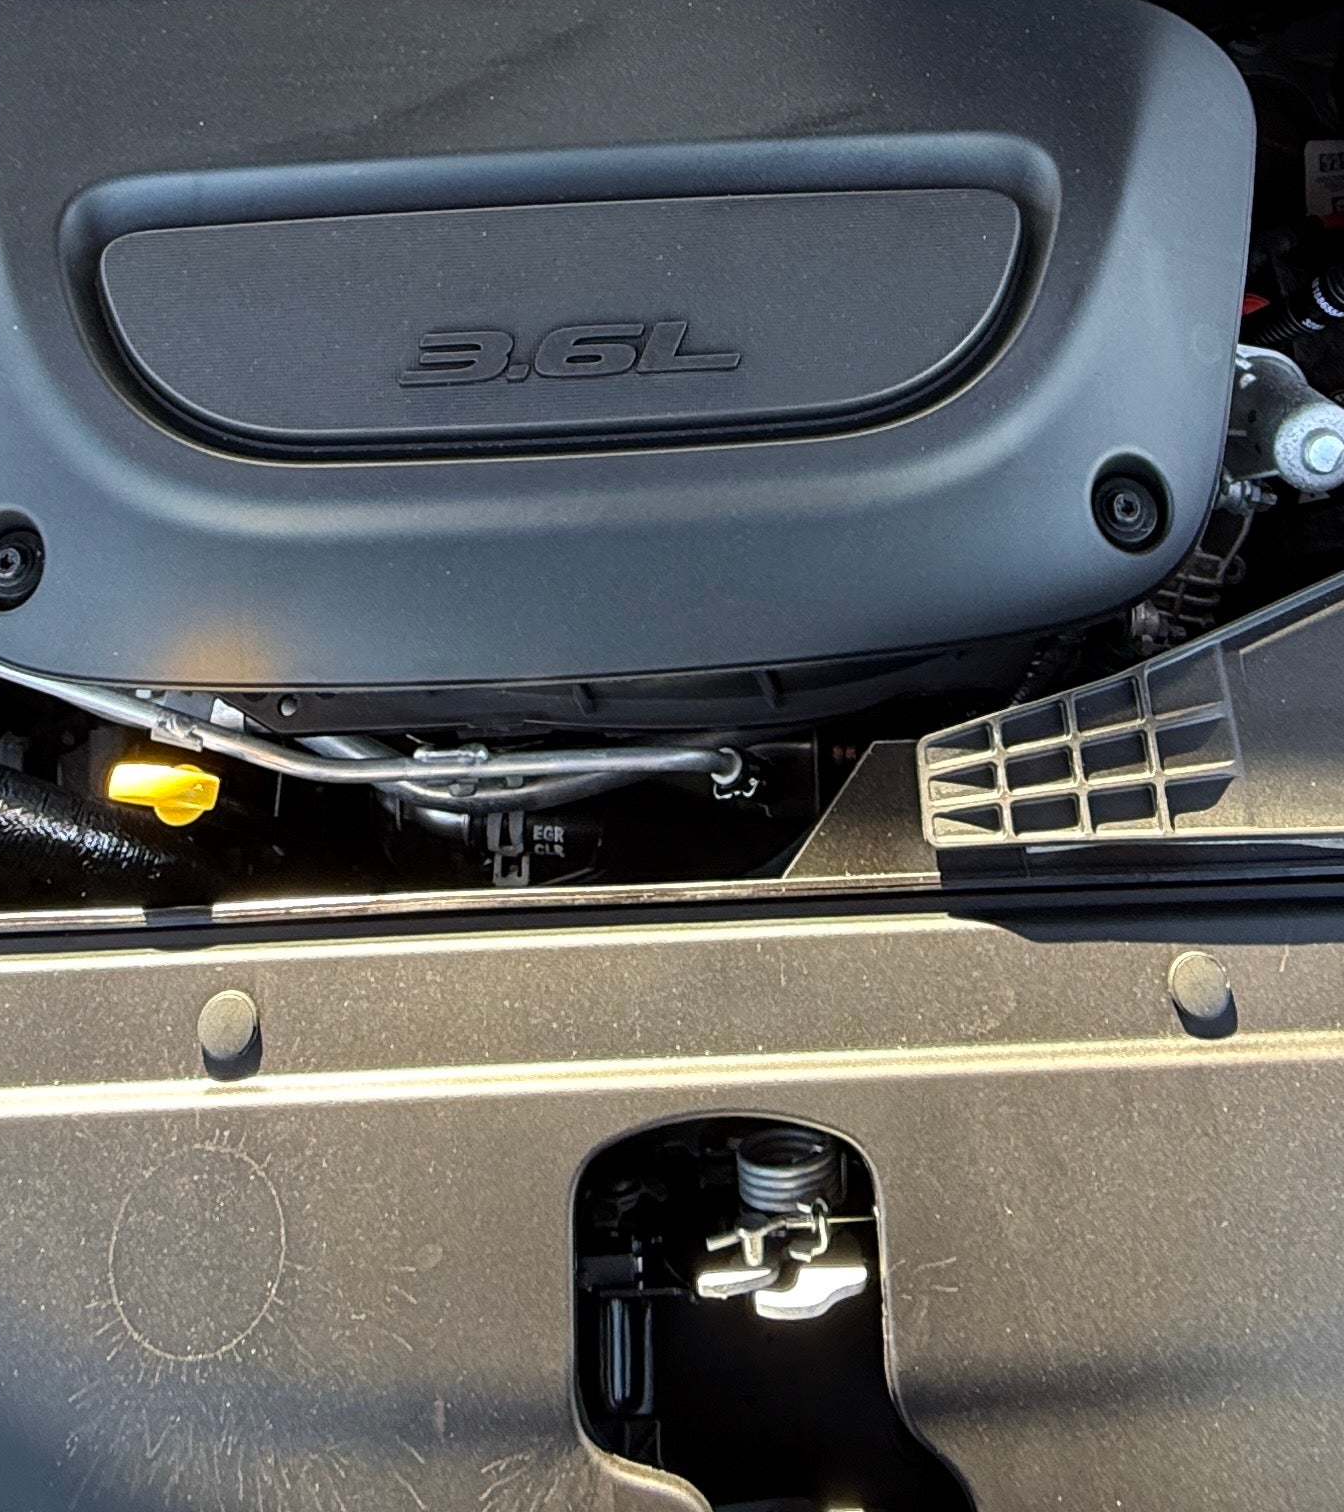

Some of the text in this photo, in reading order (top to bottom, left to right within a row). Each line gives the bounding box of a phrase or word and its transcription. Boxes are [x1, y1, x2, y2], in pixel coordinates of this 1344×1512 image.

[398, 321, 740, 388] 3.6L
[533, 825, 564, 843] EGR
[534, 843, 565, 858] CLR
